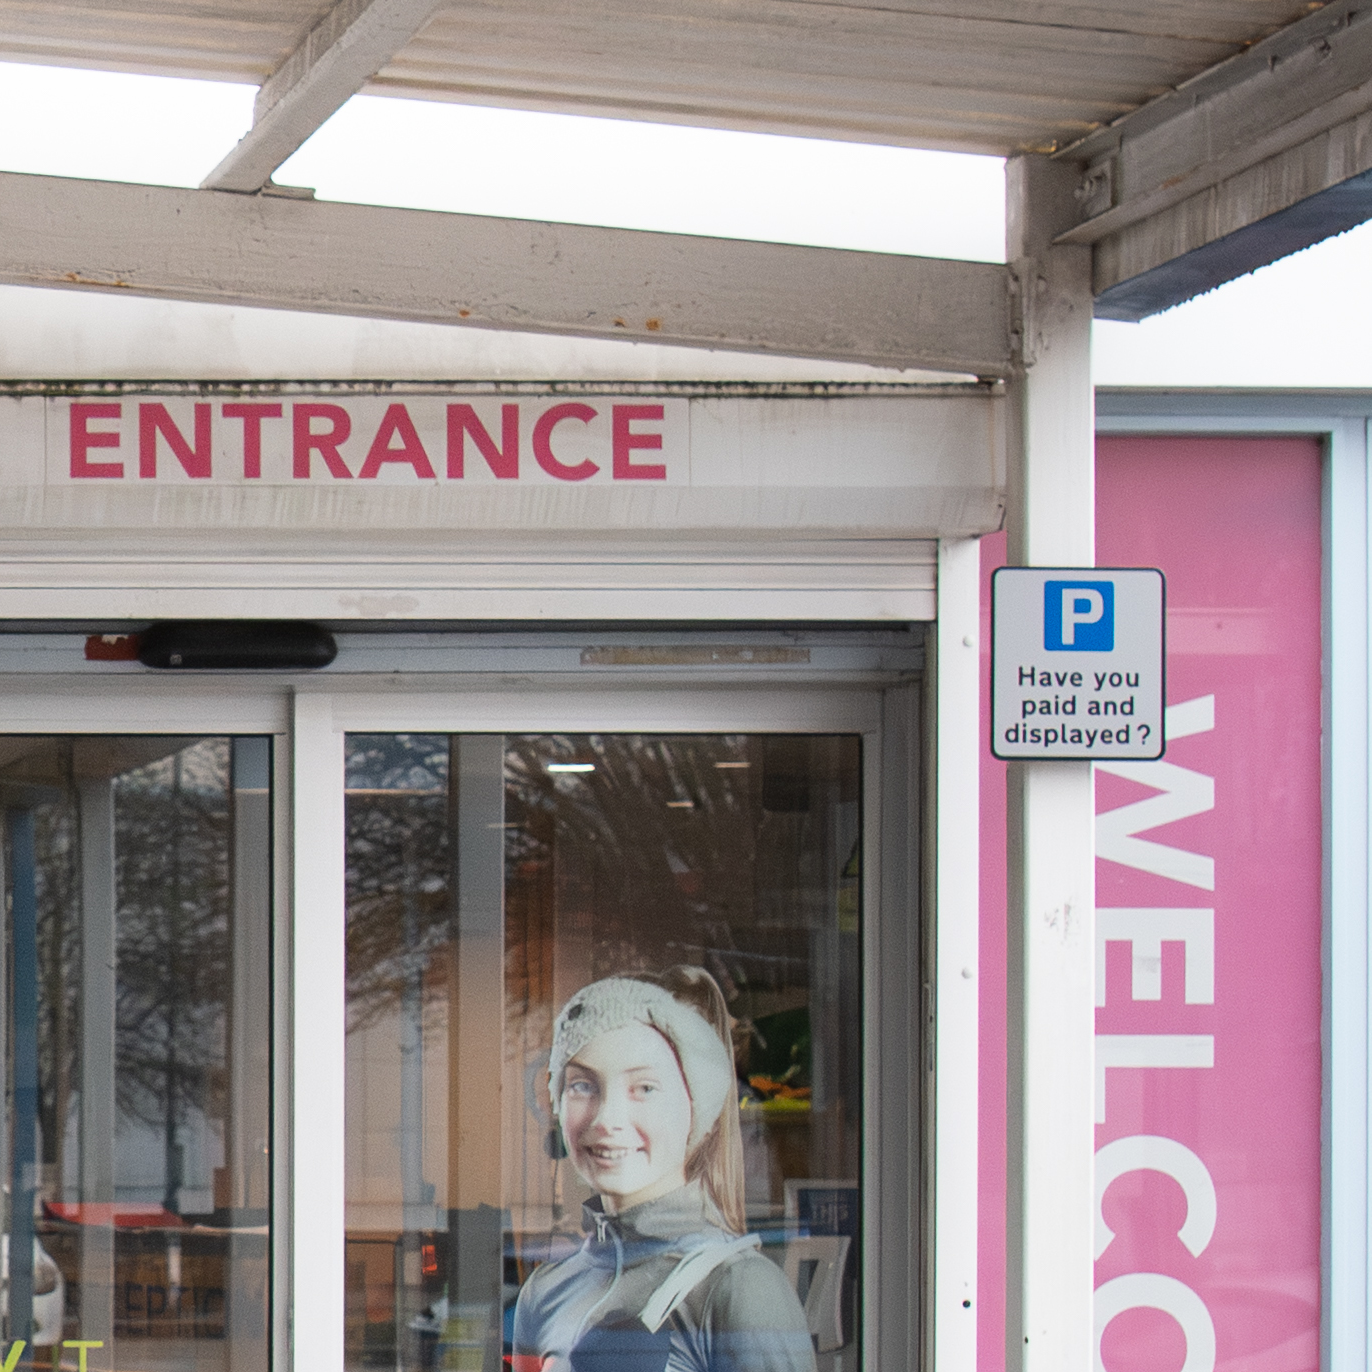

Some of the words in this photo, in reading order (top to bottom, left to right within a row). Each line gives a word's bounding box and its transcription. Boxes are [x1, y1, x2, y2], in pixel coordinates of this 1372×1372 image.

[69, 403, 666, 481] ENTRANCE
[1061, 588, 1104, 645] P
[1018, 666, 1083, 687] Have
[1093, 672, 1140, 691] you
[1021, 695, 1077, 719] paid
[1087, 695, 1135, 715] and
